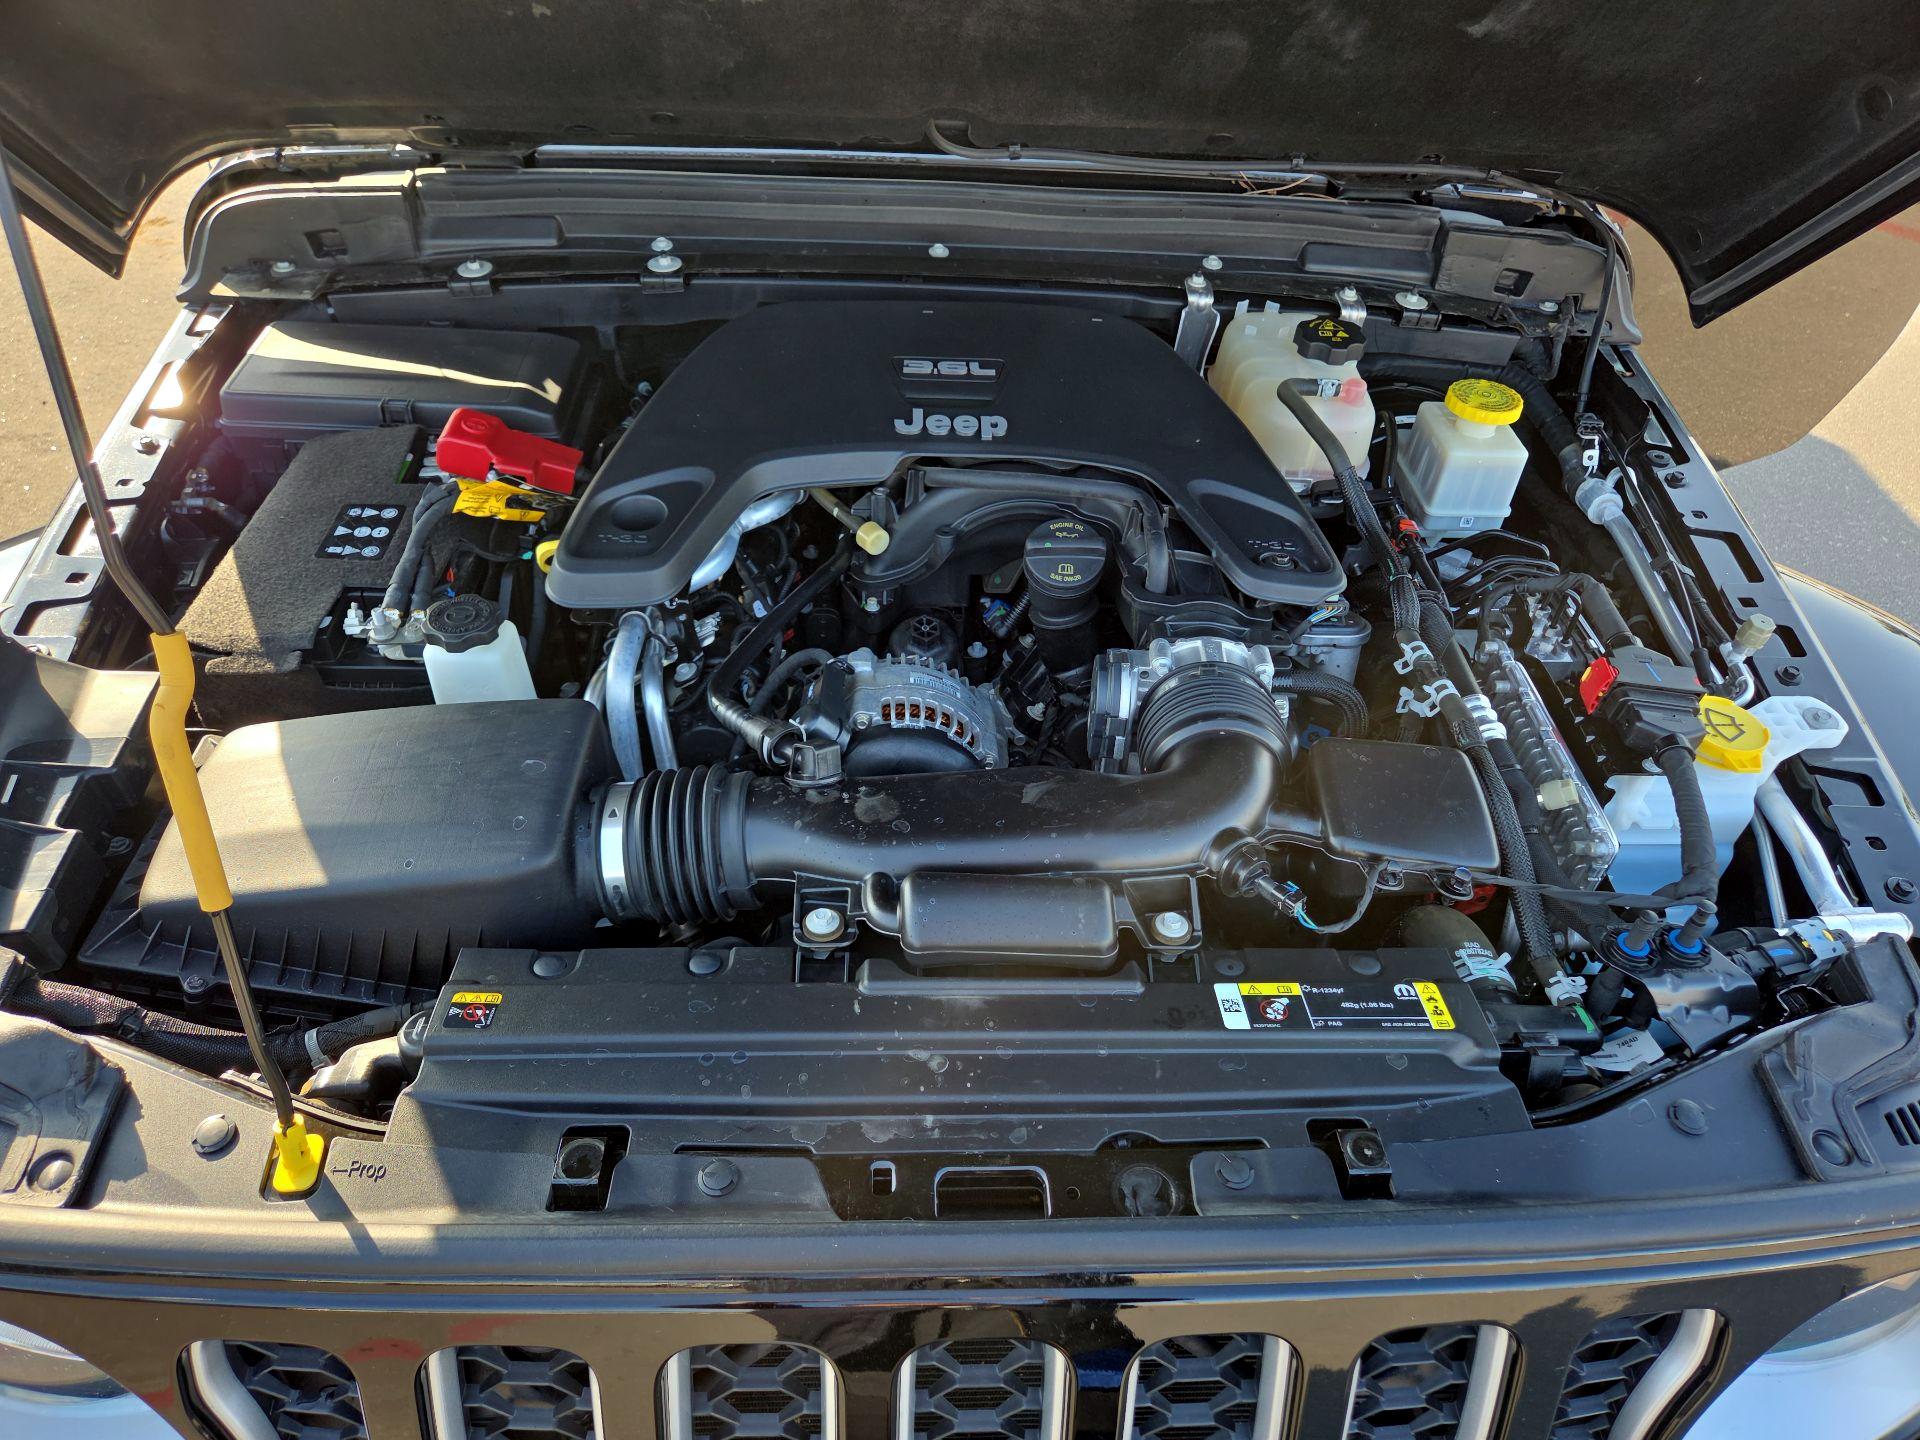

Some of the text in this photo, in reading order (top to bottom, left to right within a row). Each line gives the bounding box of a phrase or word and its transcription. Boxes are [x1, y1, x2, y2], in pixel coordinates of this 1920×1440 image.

[903, 359, 996, 376] 3.6L
[893, 407, 1008, 441] Jeep
[1049, 522, 1084, 532] ENGINE OIL
[1049, 572, 1063, 582] SAE
[348, 1160, 387, 1183] Prop
